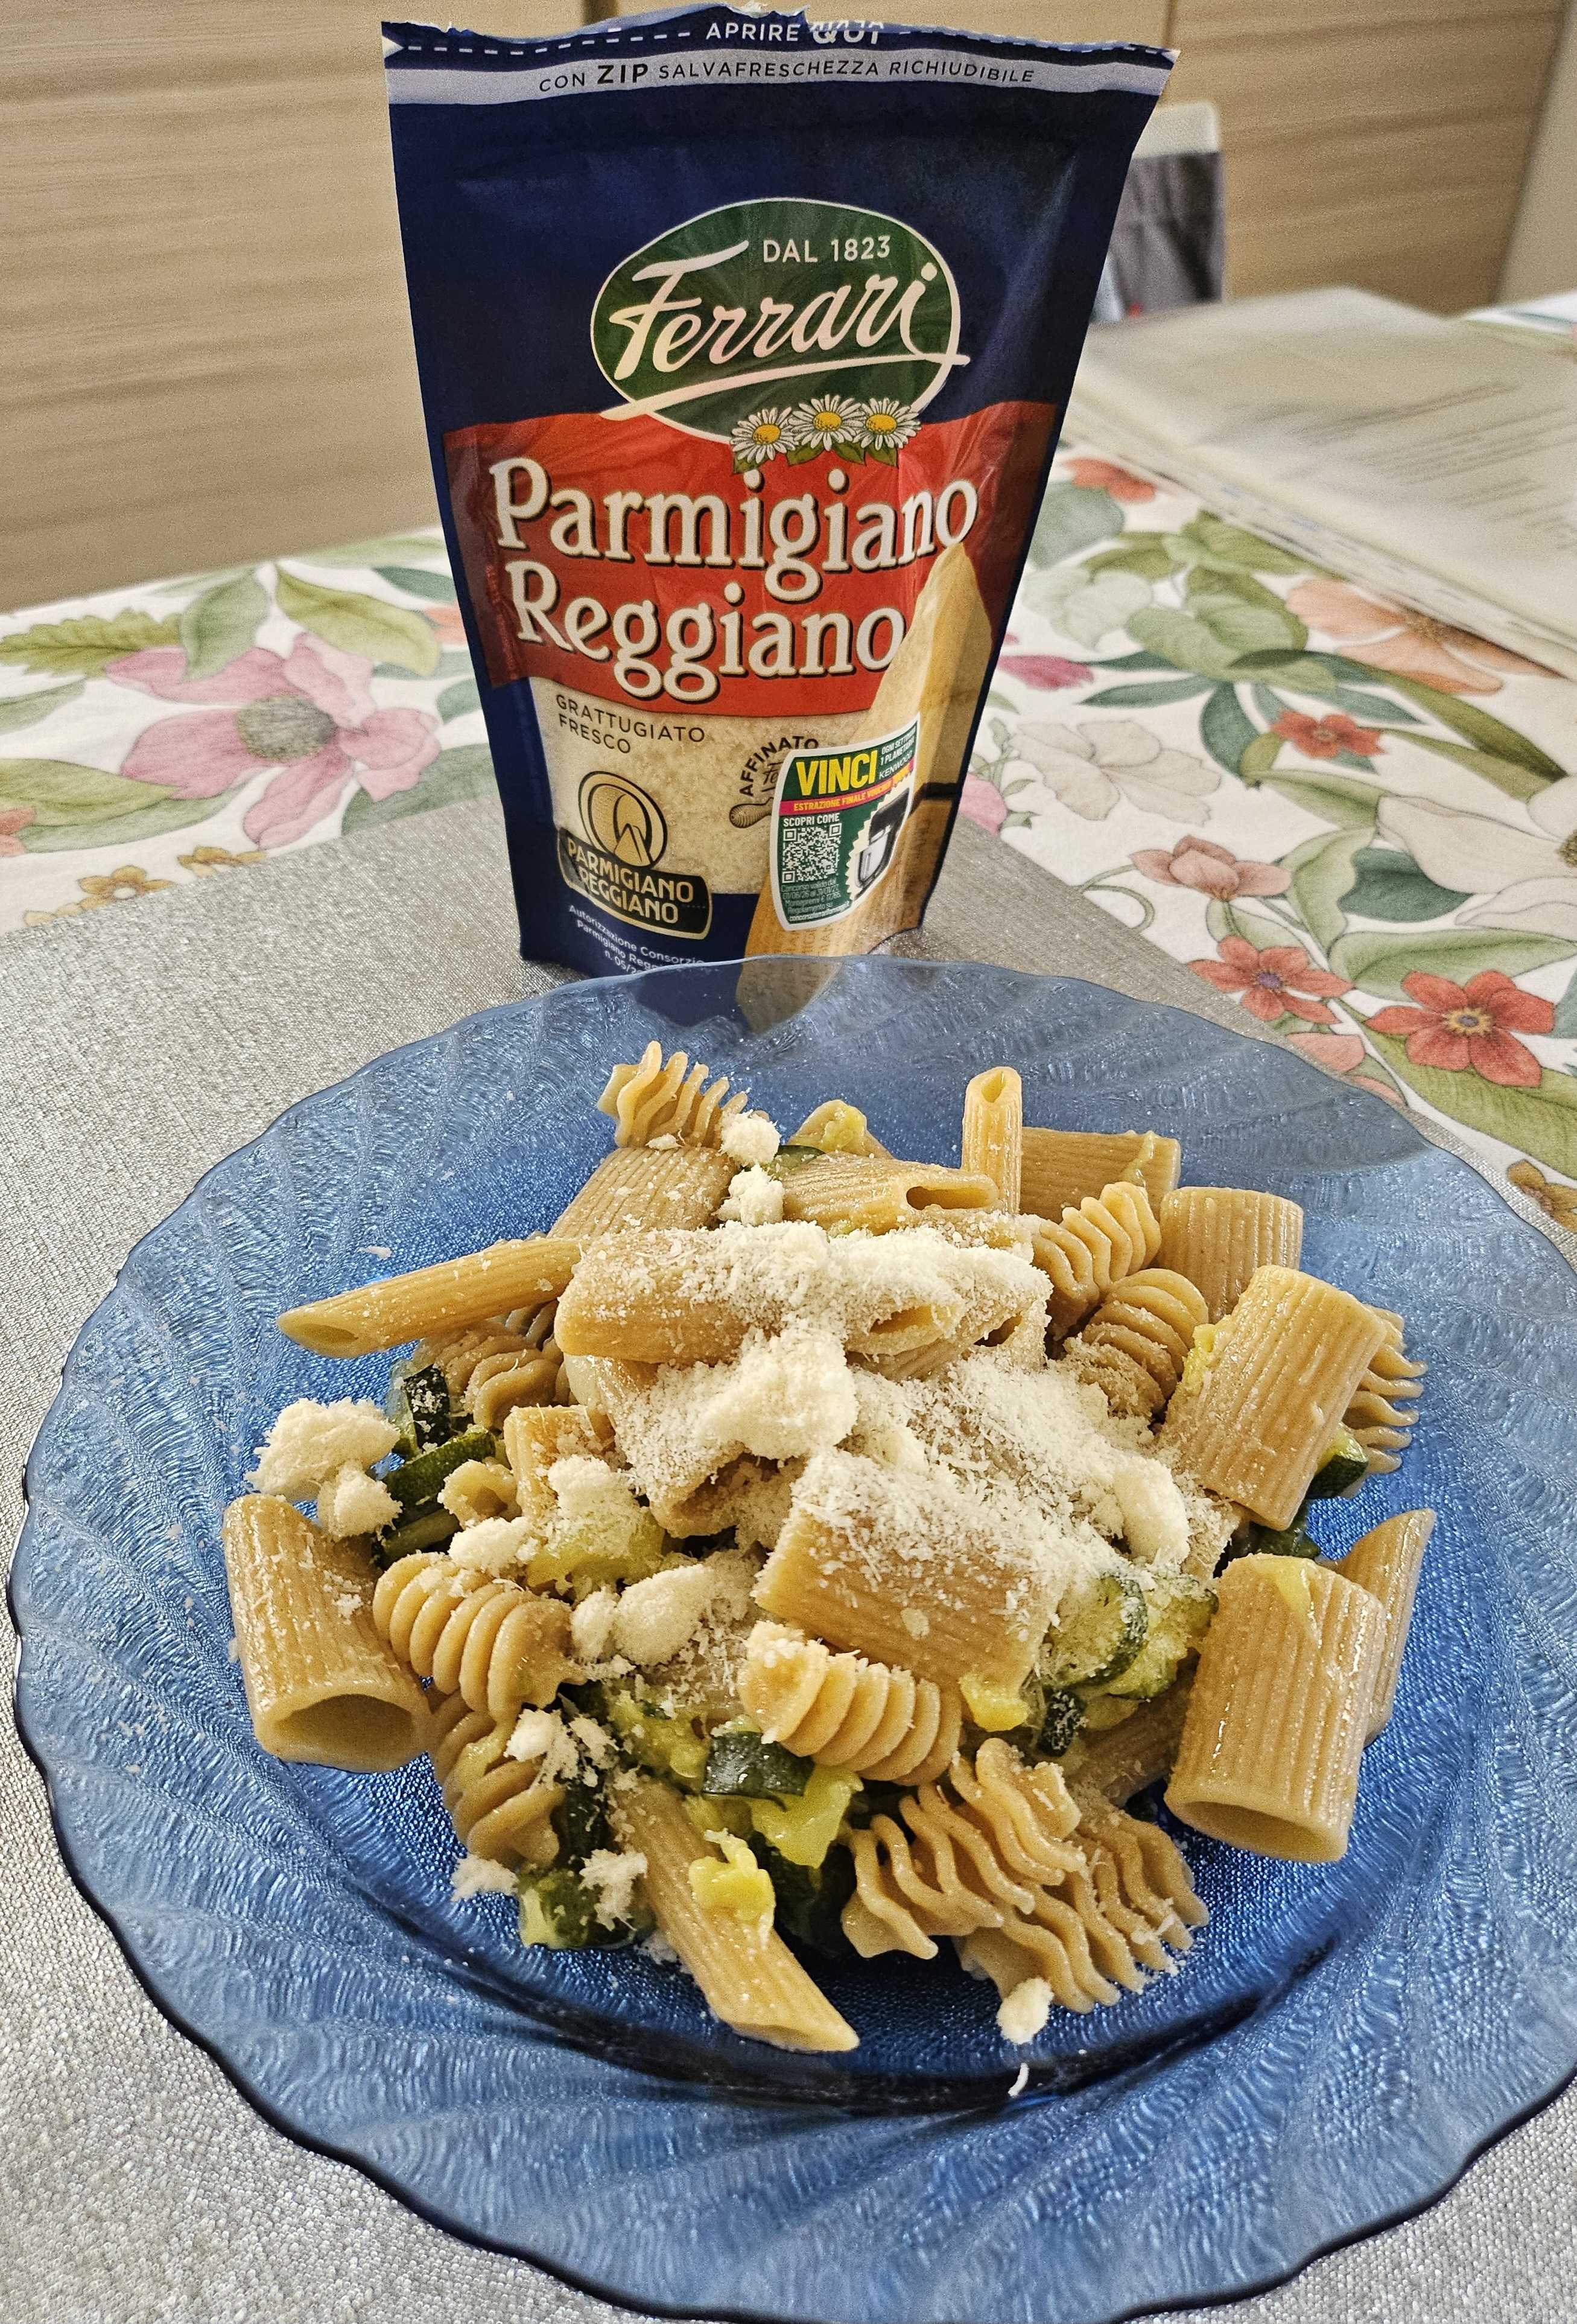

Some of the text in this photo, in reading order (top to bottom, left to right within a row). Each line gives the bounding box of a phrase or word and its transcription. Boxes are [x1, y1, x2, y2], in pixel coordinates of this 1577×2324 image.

[706, 22, 799, 42] APRIRE
[539, 60, 1035, 92] CON ZIP SALVAFRESCHEZZA RICHIUDIBILE
[763, 236, 891, 263] DAL 1823
[609, 240, 939, 380] Ferrari
[490, 457, 978, 602] Parmigiano
[506, 560, 905, 702] Reggiano
[556, 695, 705, 742] GRATTUGIATO
[559, 714, 630, 754] FRESCO
[739, 736, 819, 797] AFFINATO
[796, 750, 877, 796] VINCI
[783, 813, 840, 827] SCOPRI COME
[794, 799, 840, 811] ESTRAZIONE
[842, 793, 866, 805] FINALE
[568, 837, 694, 903] PARMIGIANO
[579, 868, 679, 923] REGGIANO
[569, 905, 637, 951] Autorizzazione
[577, 920, 626, 958] Parmigiano
